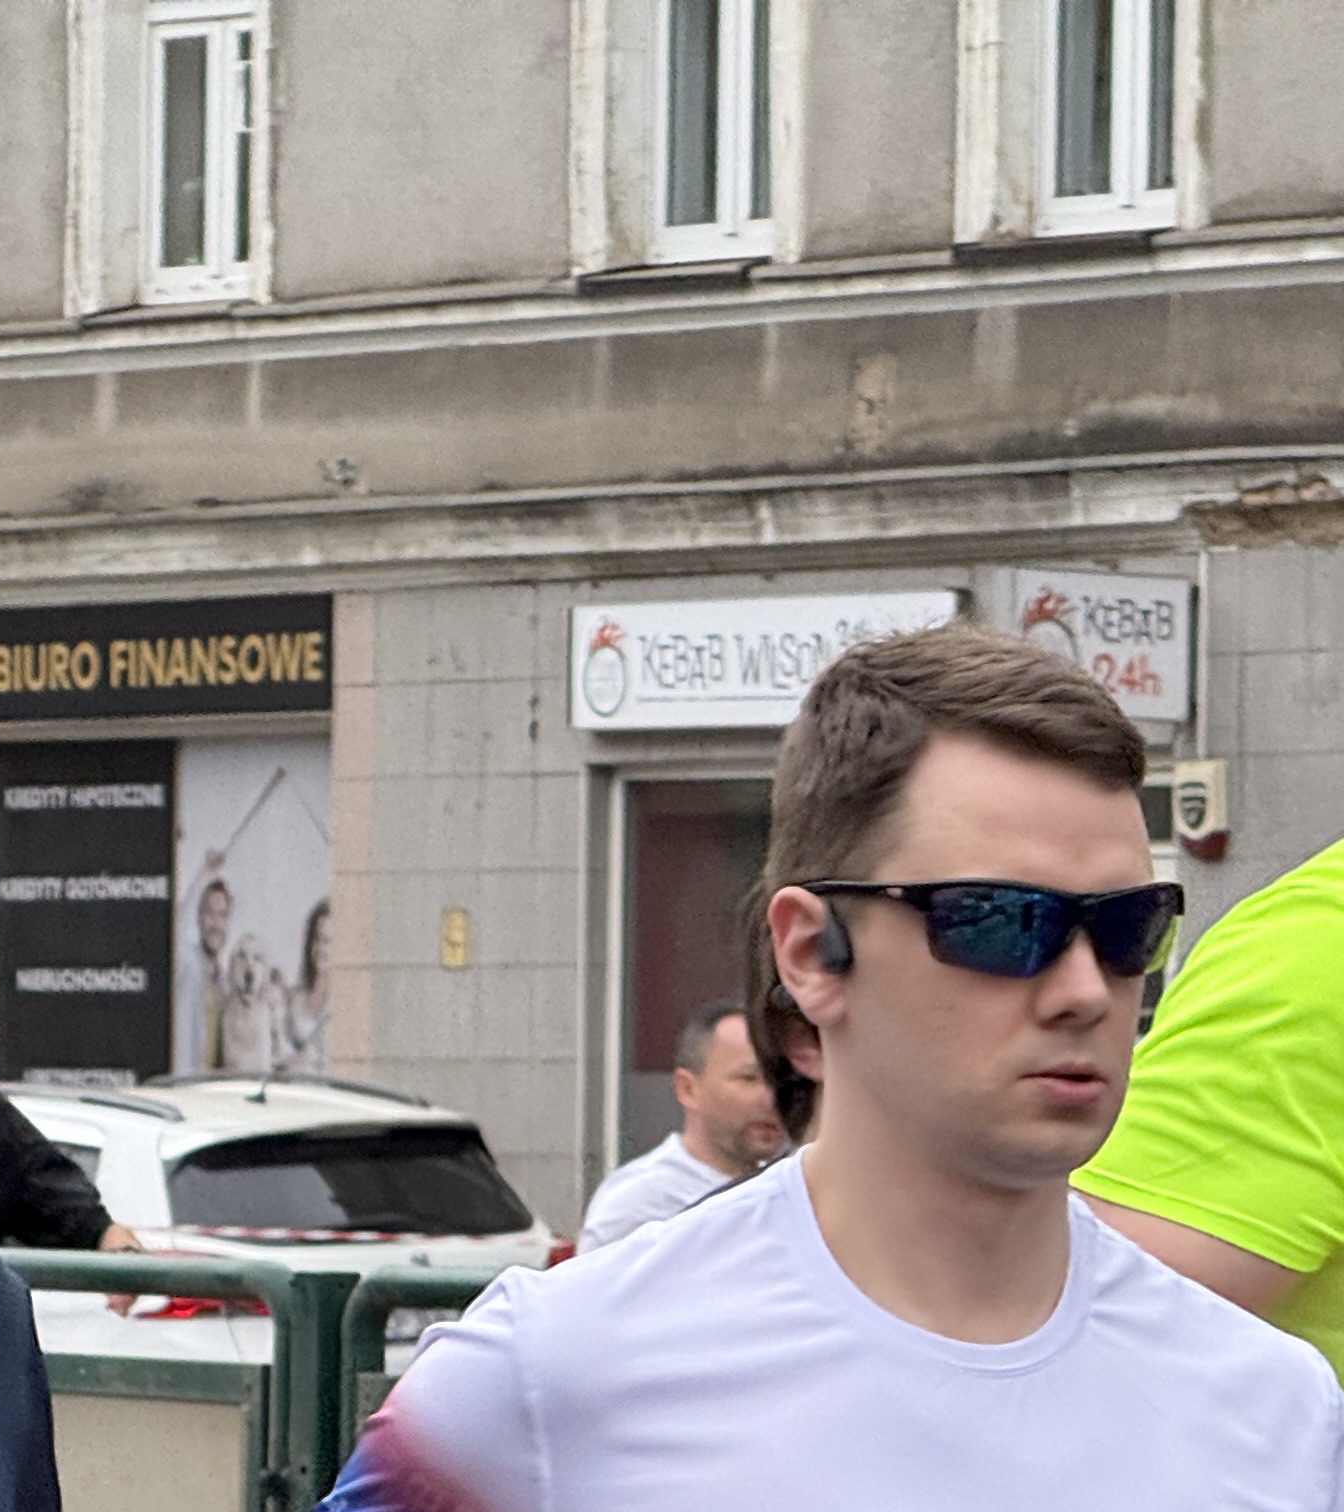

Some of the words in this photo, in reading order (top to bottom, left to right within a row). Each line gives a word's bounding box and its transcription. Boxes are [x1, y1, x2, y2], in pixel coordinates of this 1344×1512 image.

[1082, 595, 1174, 645] KEBAB
[109, 631, 324, 687] FINANSOWE
[637, 632, 725, 690] KEBAB
[3, 786, 67, 810] KREDYTY
[69, 783, 165, 809] HIPOTECZNE
[64, 868, 169, 899] GOTÓWKOWE
[16, 961, 148, 992] NIERUCHOMOŚCI
